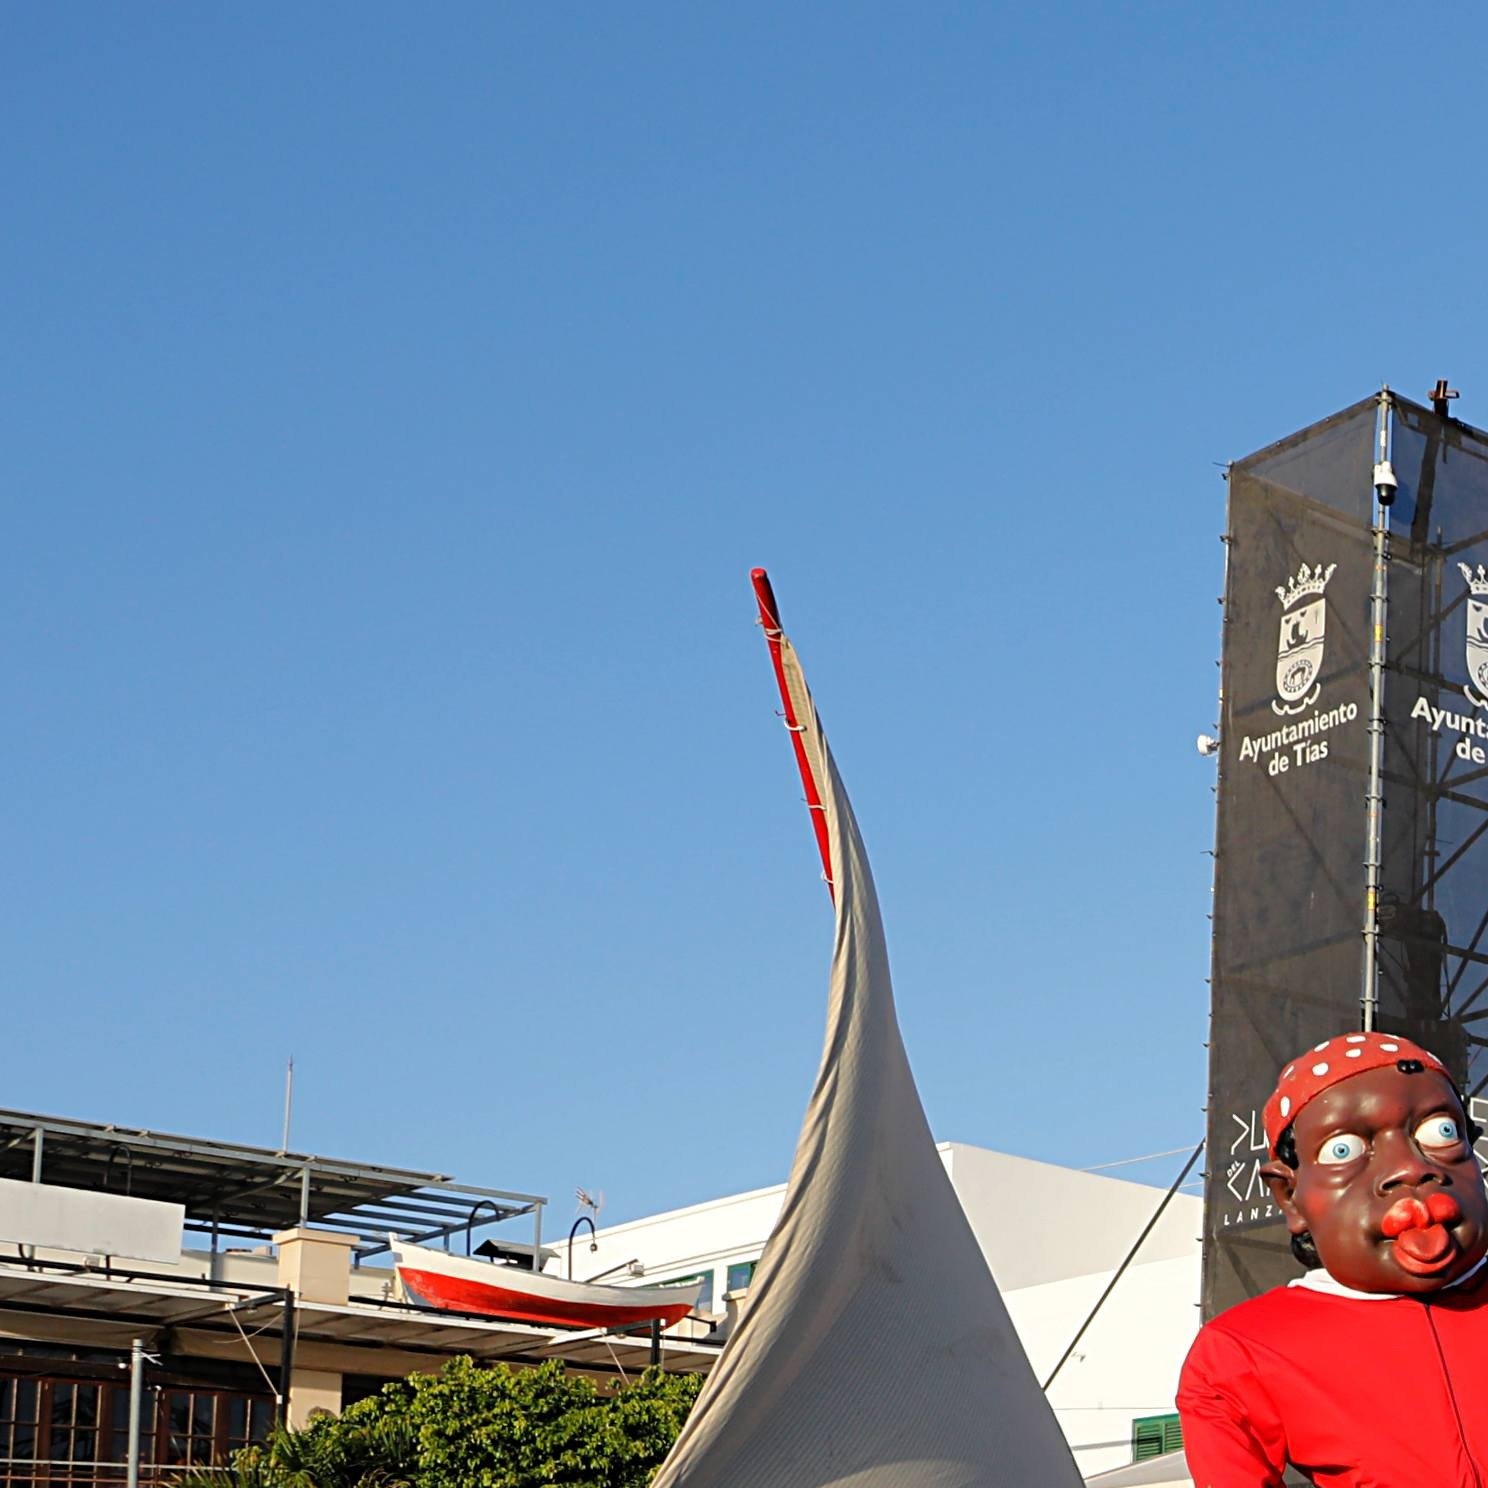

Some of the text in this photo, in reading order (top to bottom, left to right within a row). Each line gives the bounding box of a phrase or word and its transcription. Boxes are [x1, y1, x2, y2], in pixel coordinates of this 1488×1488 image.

[1239, 702, 1358, 762] Ayuntamiento
[1268, 740, 1328, 776] de Tías
[1456, 740, 1488, 765] de
